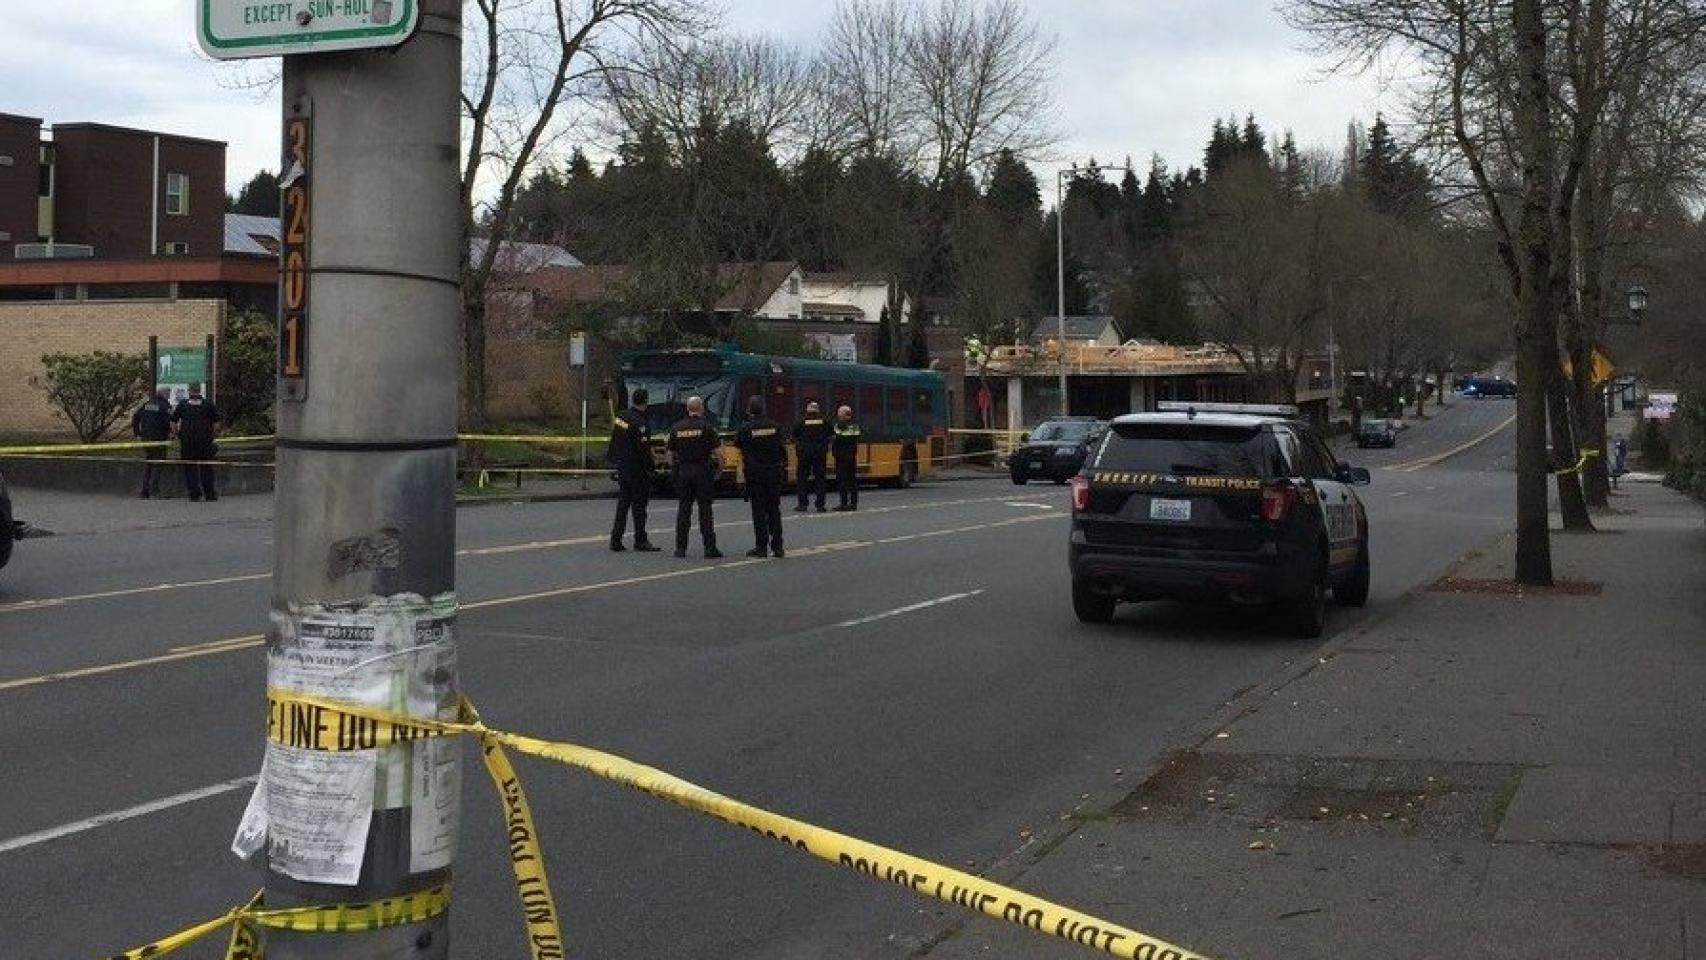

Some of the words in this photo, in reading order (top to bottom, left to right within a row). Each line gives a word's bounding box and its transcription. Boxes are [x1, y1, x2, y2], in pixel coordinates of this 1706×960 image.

[244, 4, 292, 24] EXCEPT
[1093, 472, 1158, 483] SHERIFF
[1185, 476, 1225, 487] TRANSIT
[1227, 479, 1261, 489] POLICE
